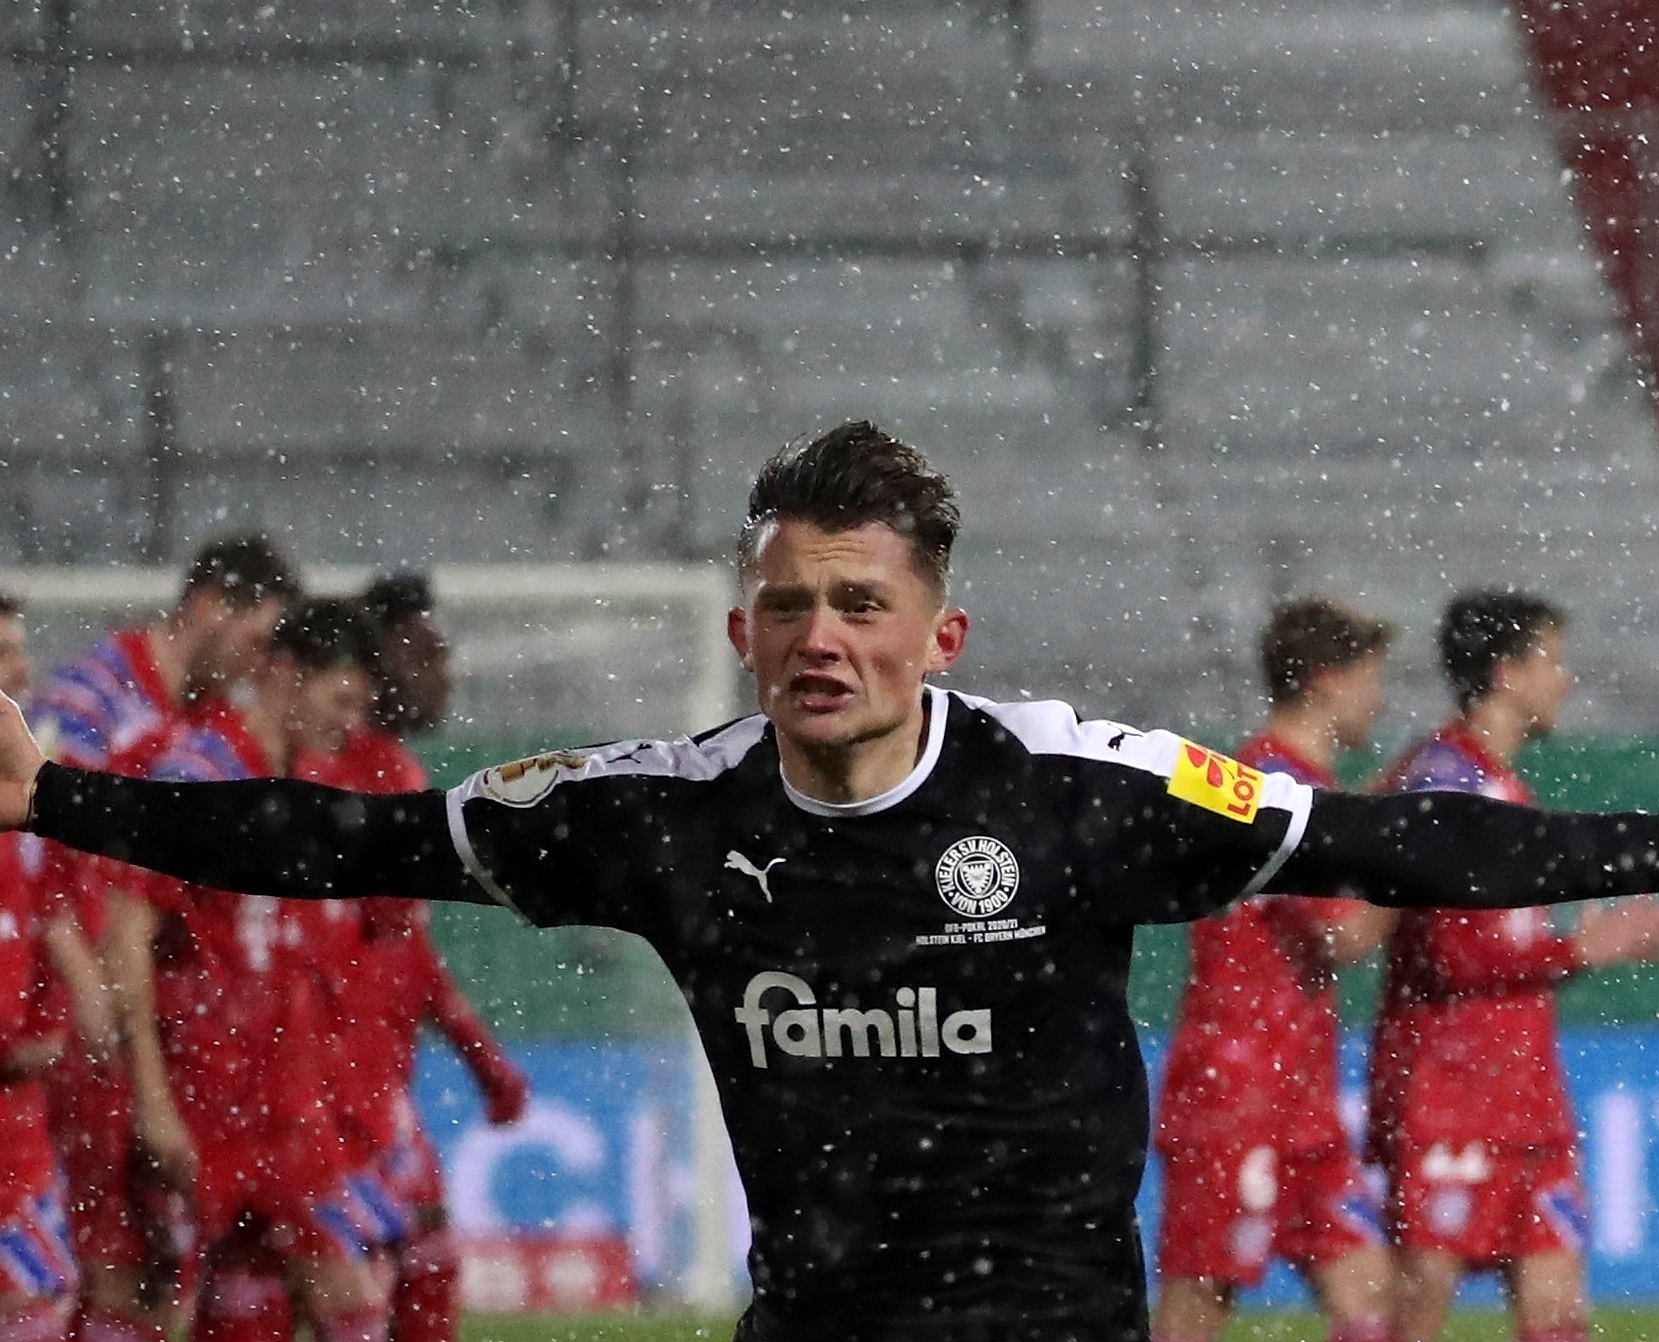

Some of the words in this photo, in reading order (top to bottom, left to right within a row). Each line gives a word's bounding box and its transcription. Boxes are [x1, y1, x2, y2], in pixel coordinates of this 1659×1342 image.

[951, 891, 977, 914] VON
[979, 889, 1009, 914] 1900
[734, 970, 993, 1069] famila
